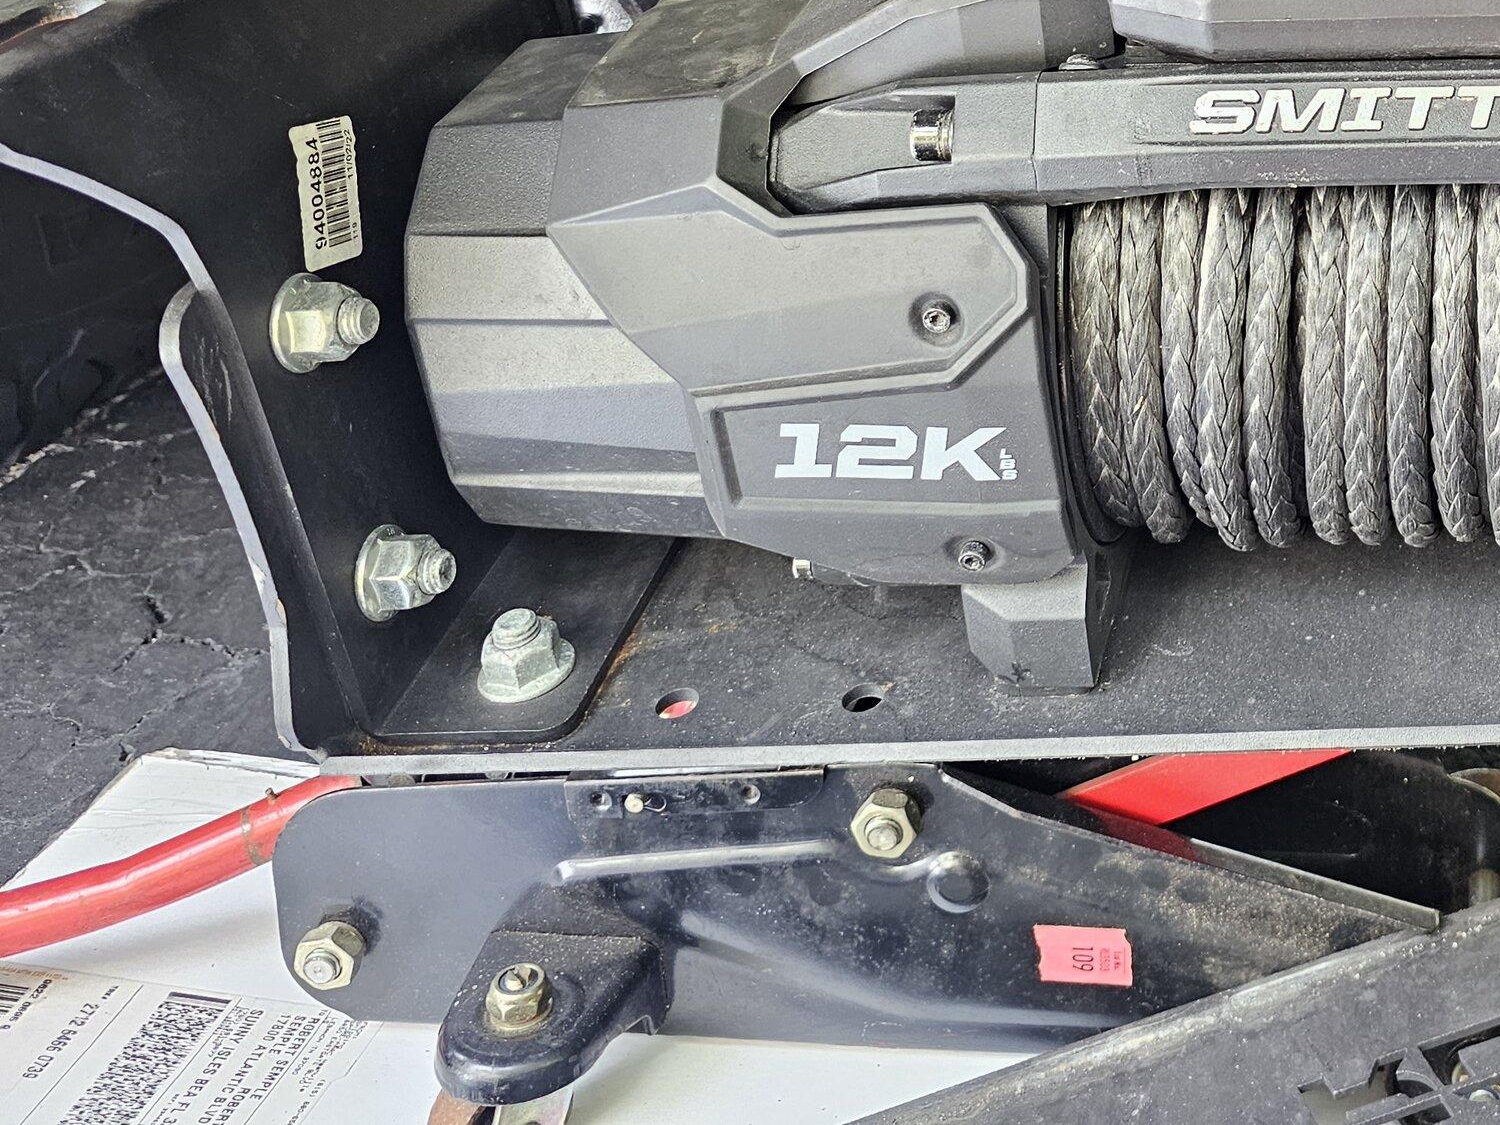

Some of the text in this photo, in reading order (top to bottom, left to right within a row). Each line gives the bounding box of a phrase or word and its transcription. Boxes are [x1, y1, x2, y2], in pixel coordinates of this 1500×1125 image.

[344, 129, 354, 179] 11/02/22
[306, 137, 328, 250] 94004884
[774, 423, 1019, 481] 12K LBS
[1072, 947, 1094, 972] 109
[69, 1003, 100, 1027] 2712
[229, 1009, 264, 1044] SUNNY
[263, 1014, 291, 1042] 17800
[46, 1029, 78, 1052] 6466
[269, 1015, 307, 1055] SEMPLE
[285, 1017, 320, 1056] ROBERT
[22, 1055, 54, 1079] 0739
[203, 1047, 235, 1075] ISLES
[222, 1044, 268, 1094] ATLANTIC
[183, 1078, 210, 1097] BEA
[252, 1059, 289, 1100] SEMPLE
[170, 1101, 190, 1113] FL
[198, 1097, 227, 1124] BLVD
